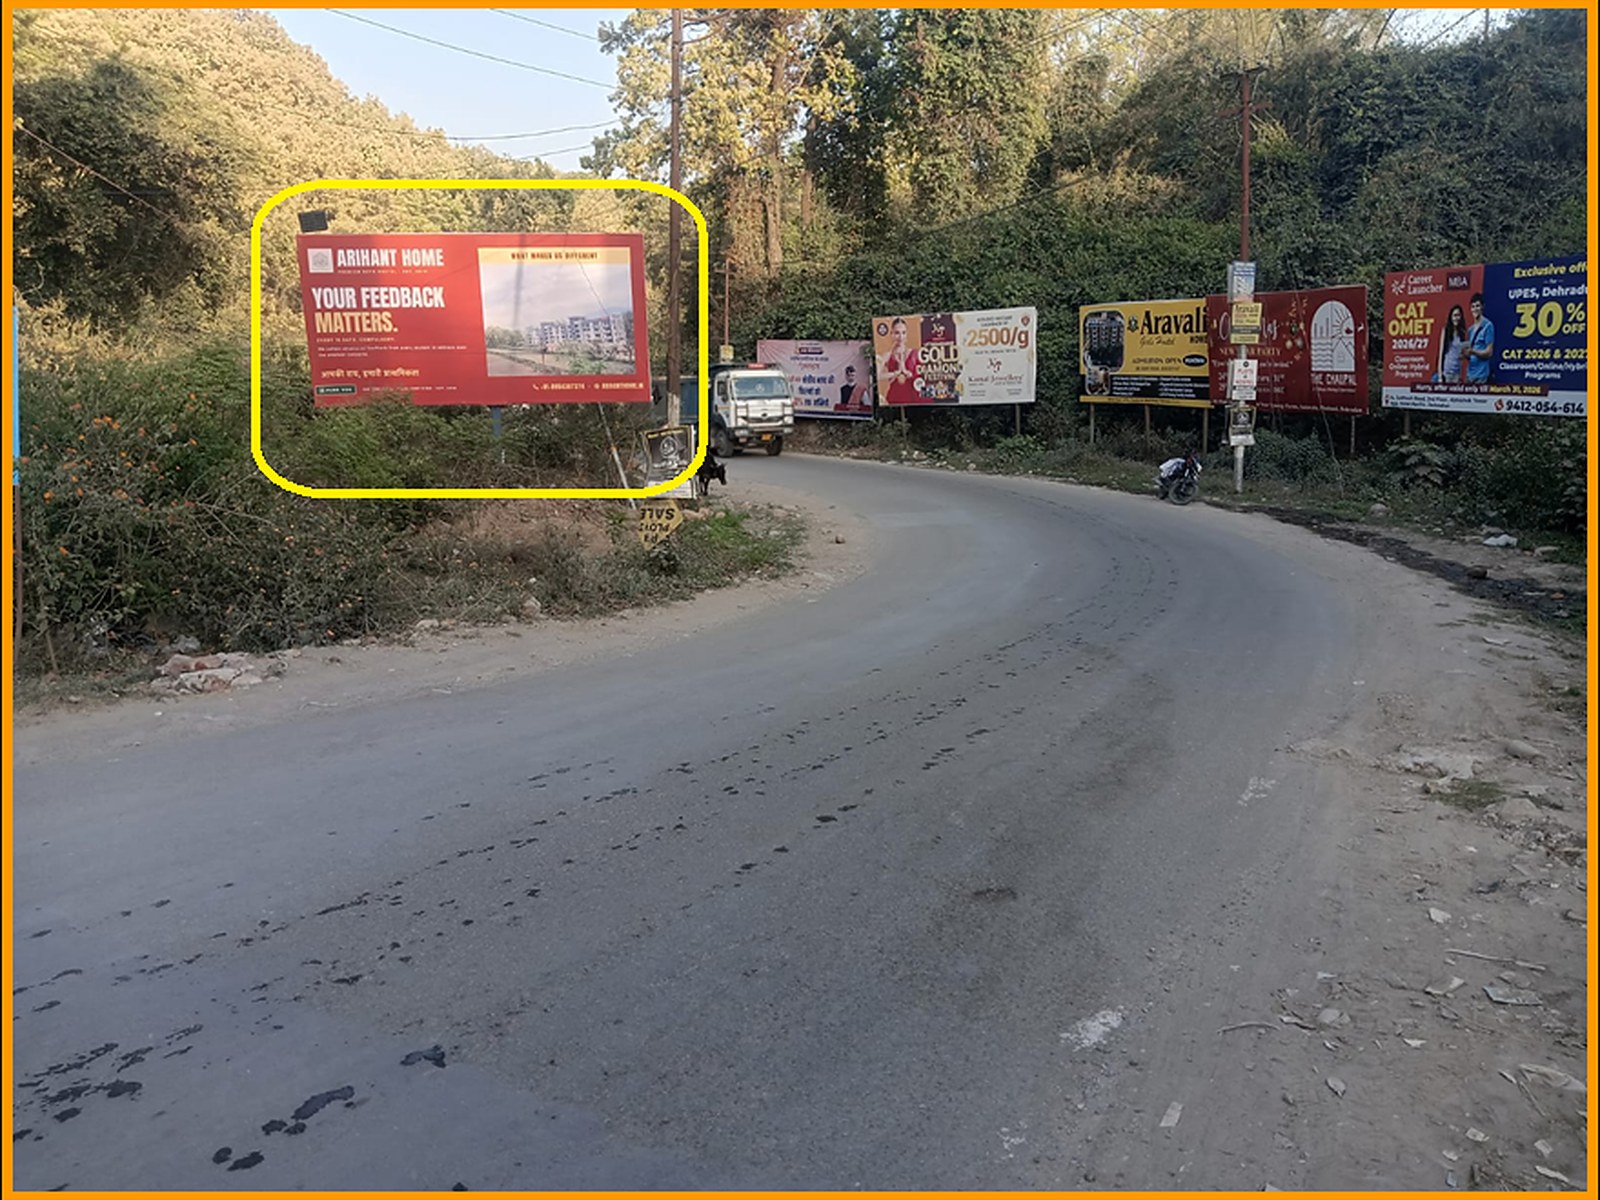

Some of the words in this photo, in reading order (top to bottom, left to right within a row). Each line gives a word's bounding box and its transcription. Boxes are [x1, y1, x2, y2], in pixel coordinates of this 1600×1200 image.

[337, 248, 397, 268] ARIHANT
[401, 248, 445, 267] HOME
[1514, 264, 1566, 279] Exclusive
[1568, 261, 1588, 274] off
[1407, 274, 1433, 284] Career
[1448, 276, 1468, 288] MBA
[311, 286, 357, 309] YOUR
[361, 286, 445, 308] FEEDBACK
[1407, 284, 1443, 296] Launcher
[1508, 287, 1540, 300] UPES,
[1395, 301, 1428, 319] CAT
[314, 311, 398, 333] MATTERS.
[1140, 306, 1208, 336] Aravali
[1388, 319, 1435, 337] OMET
[1512, 301, 1563, 338] 30
[1566, 302, 1586, 322] %
[1562, 322, 1586, 335] OFF
[1392, 337, 1430, 350] 2026/27
[918, 346, 959, 363] GOLD
[1502, 349, 1523, 361] CAT
[1524, 348, 1551, 360] 2026
[1552, 348, 1562, 359] &
[916, 362, 963, 375] DIAMOND
[1524, 371, 1562, 381] Programs
[1311, 372, 1324, 386] THE
[1326, 373, 1357, 386] CHAUPAL
[1506, 398, 1585, 415] 9412-054-614
